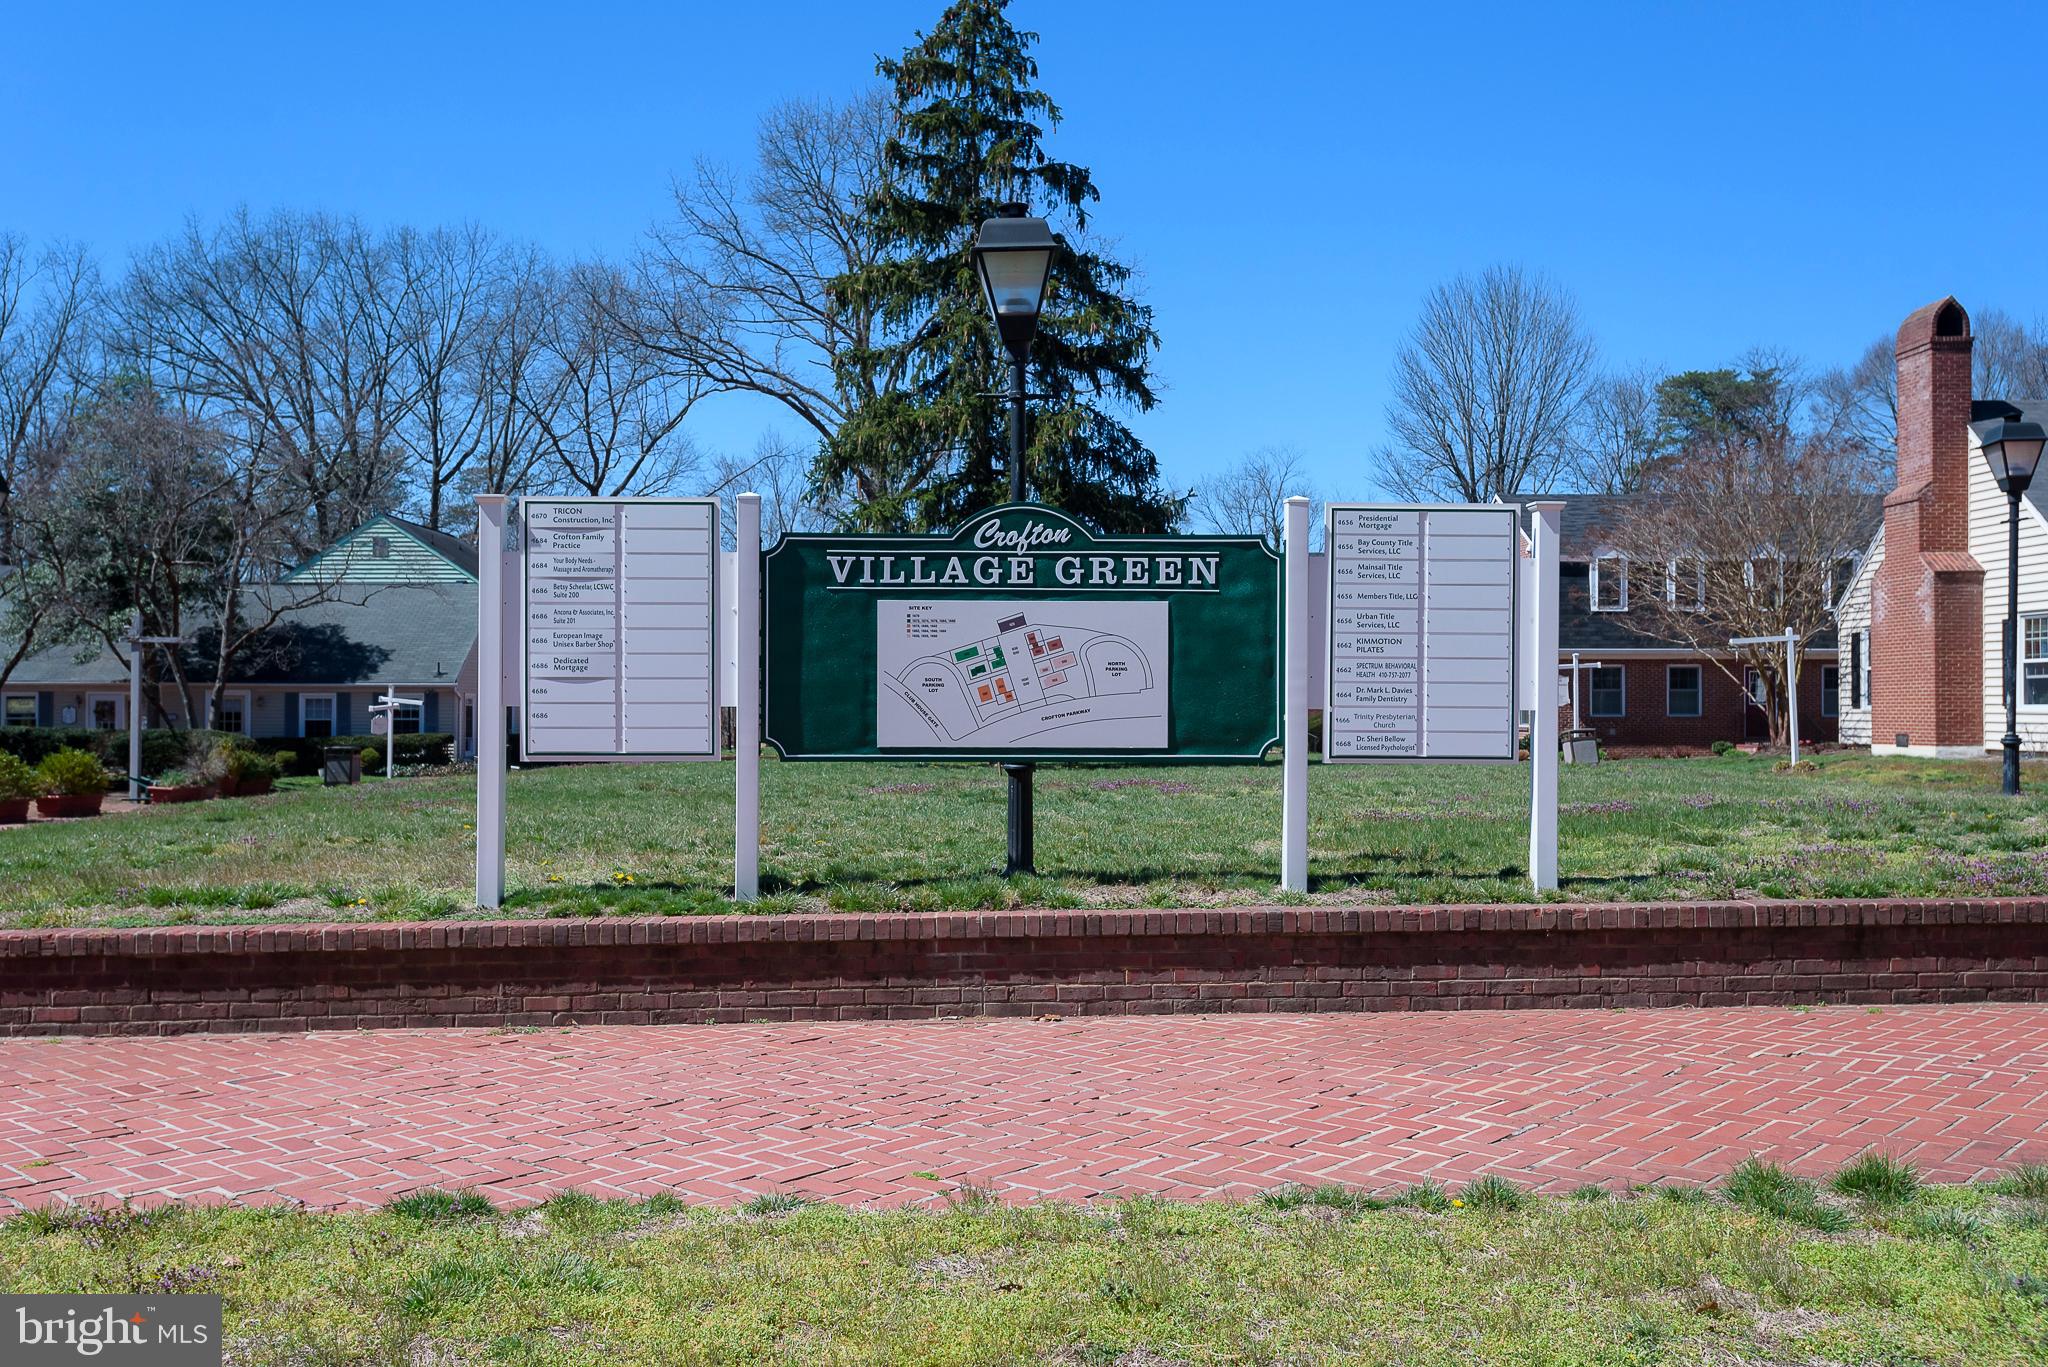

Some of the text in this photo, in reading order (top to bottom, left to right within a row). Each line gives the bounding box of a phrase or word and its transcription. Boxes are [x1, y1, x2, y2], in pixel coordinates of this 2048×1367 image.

[974, 518, 1071, 555] Crofton
[1358, 539, 1370, 547] Bay
[1372, 539, 1396, 547] County
[582, 566, 614, 574] Aromatherapy
[827, 555, 1221, 587] VILLAGE GREEN
[598, 641, 614, 649] Shop
[914, 702, 928, 717] HOUSE
[927, 715, 939, 728] GATE
[1041, 709, 1091, 721] CROFTON PARKWAY
